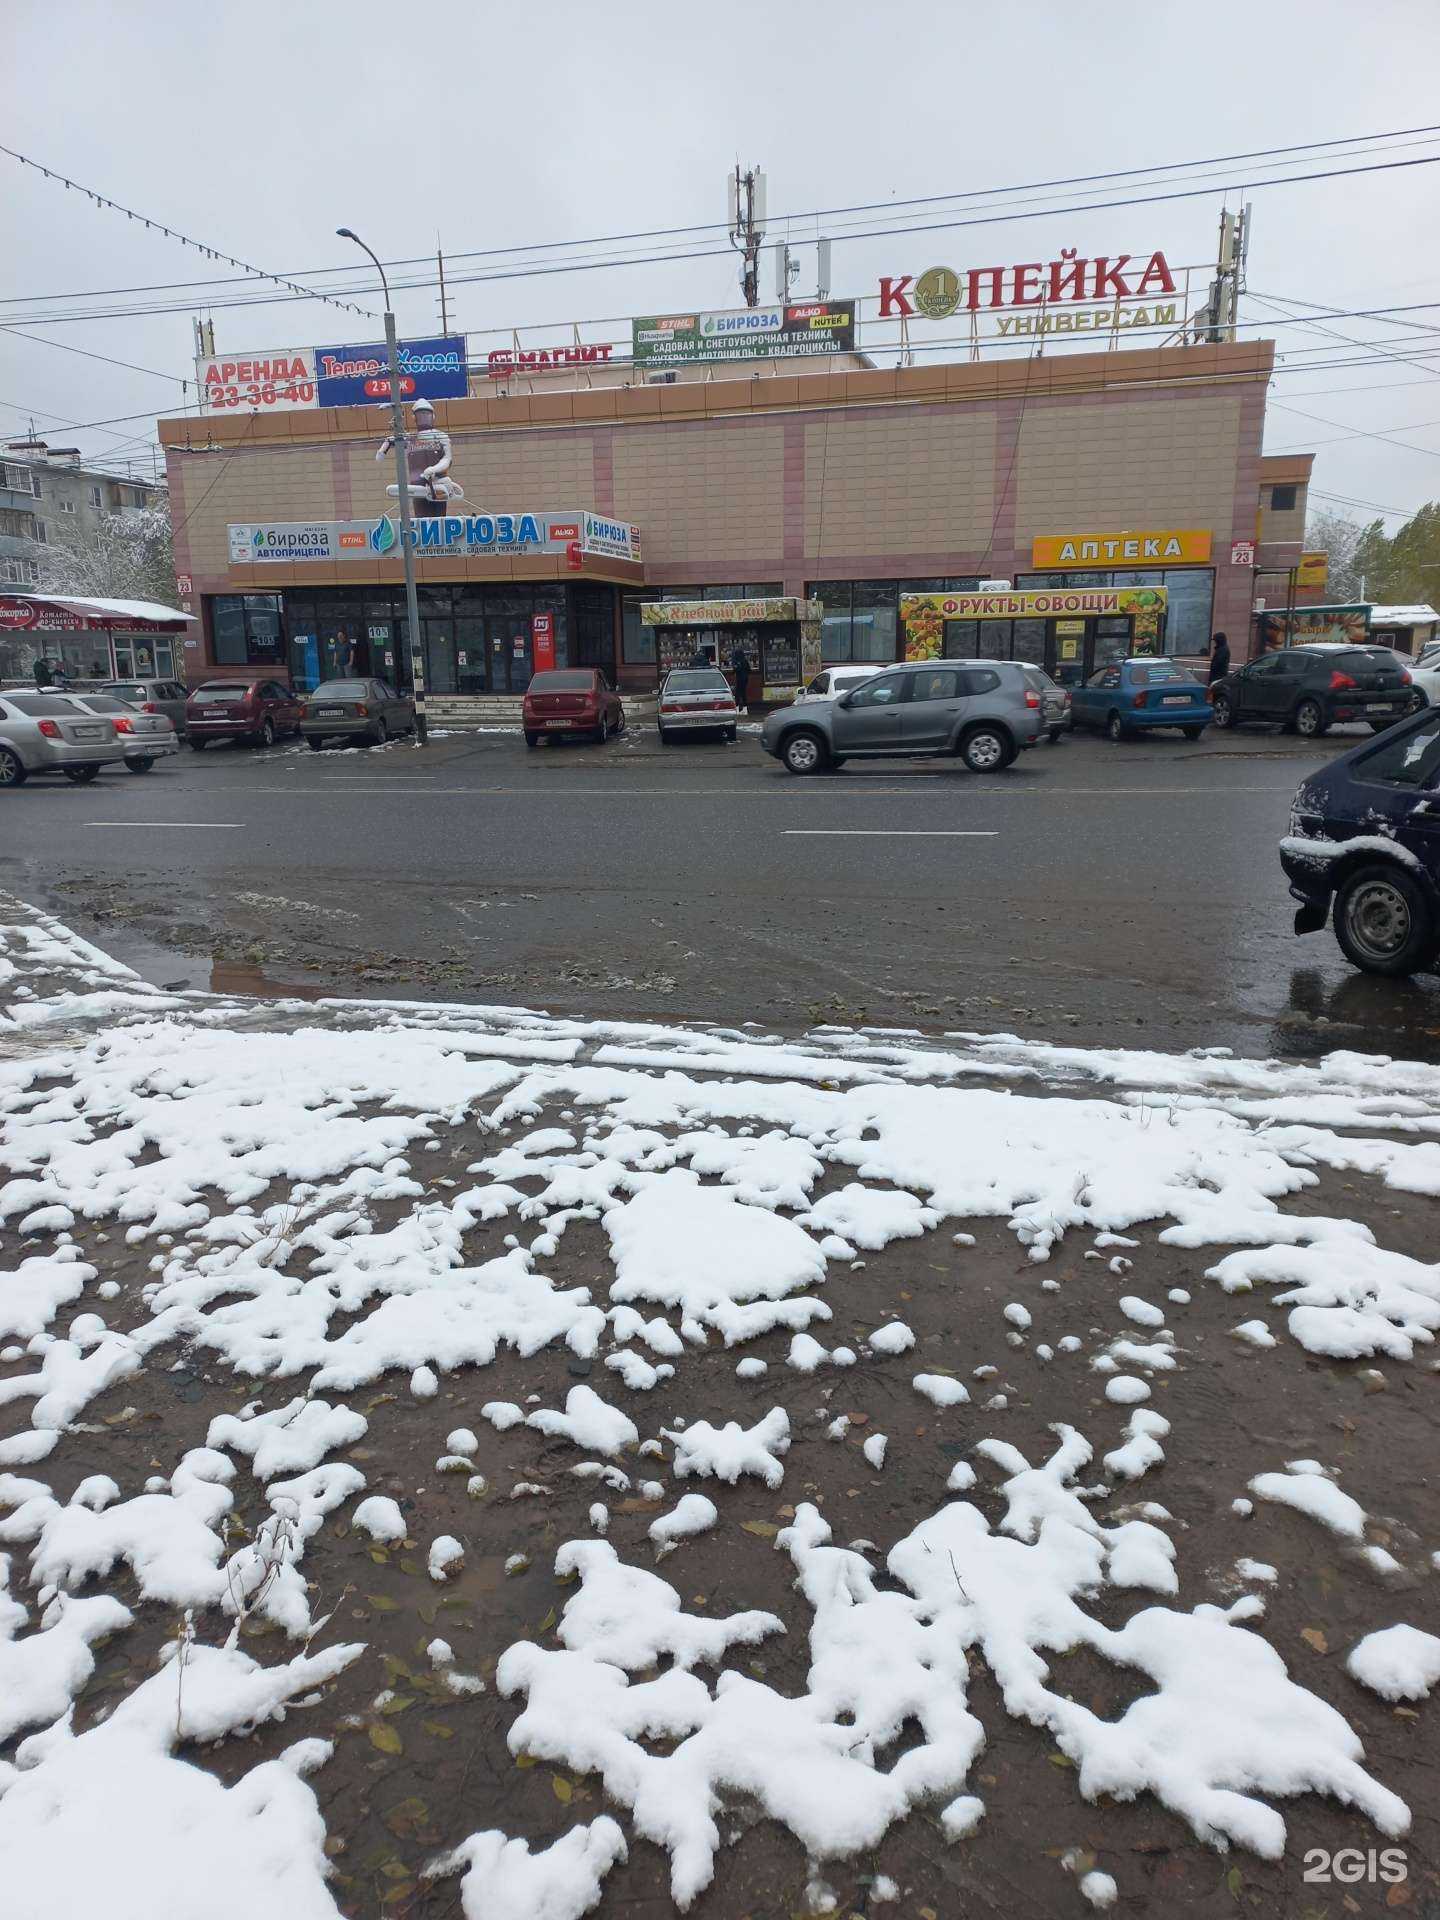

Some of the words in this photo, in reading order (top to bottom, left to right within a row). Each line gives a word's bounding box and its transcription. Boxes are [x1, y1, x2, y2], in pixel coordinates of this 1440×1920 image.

[661, 319, 690, 328] STIHL
[716, 316, 779, 331] БИРЮЗА
[997, 303, 1176, 336] УНИВЕРСАМ
[653, 341, 694, 353] САДОВАЯ
[697, 340, 703, 349] И
[706, 332, 789, 349] СНЕГОУБОРОЧНАЯ
[792, 329, 832, 343] ТЕХНИКА
[768, 341, 840, 356] КВАДРОЦИКЛЫ
[206, 357, 308, 384] АРЕНДА
[267, 530, 329, 548] бирюза
[342, 536, 363, 544] STIHL
[593, 521, 627, 544] БИРЮЗА
[257, 547, 329, 557] АВТОПРИЦЕПЫ
[1058, 538, 1177, 561] АПТЕКА
[1235, 552, 1249, 563] 23
[943, 594, 1119, 615] ФРУКТЫ-ОВОЩИ
